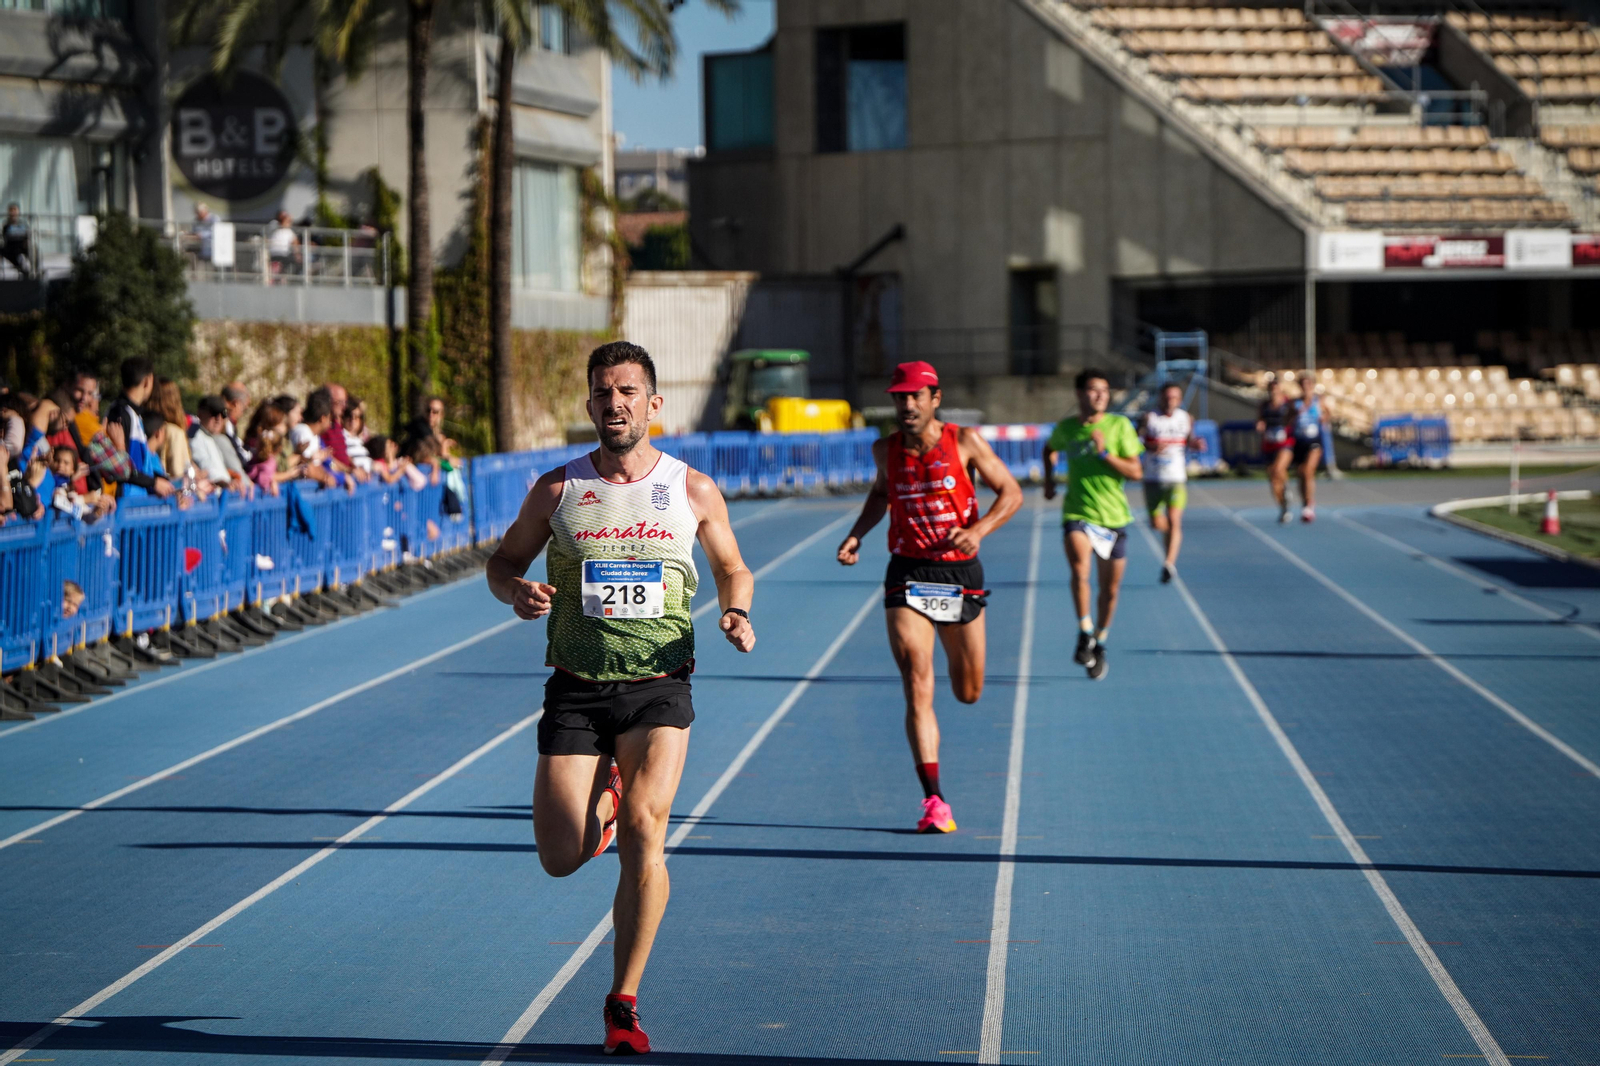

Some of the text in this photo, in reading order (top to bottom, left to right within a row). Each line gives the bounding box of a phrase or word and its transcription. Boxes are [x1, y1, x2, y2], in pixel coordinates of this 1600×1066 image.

[193, 158, 276, 178] HOTELS
[574, 521, 674, 541] maratón
[602, 584, 646, 605] 218
[921, 599, 949, 610] 306
